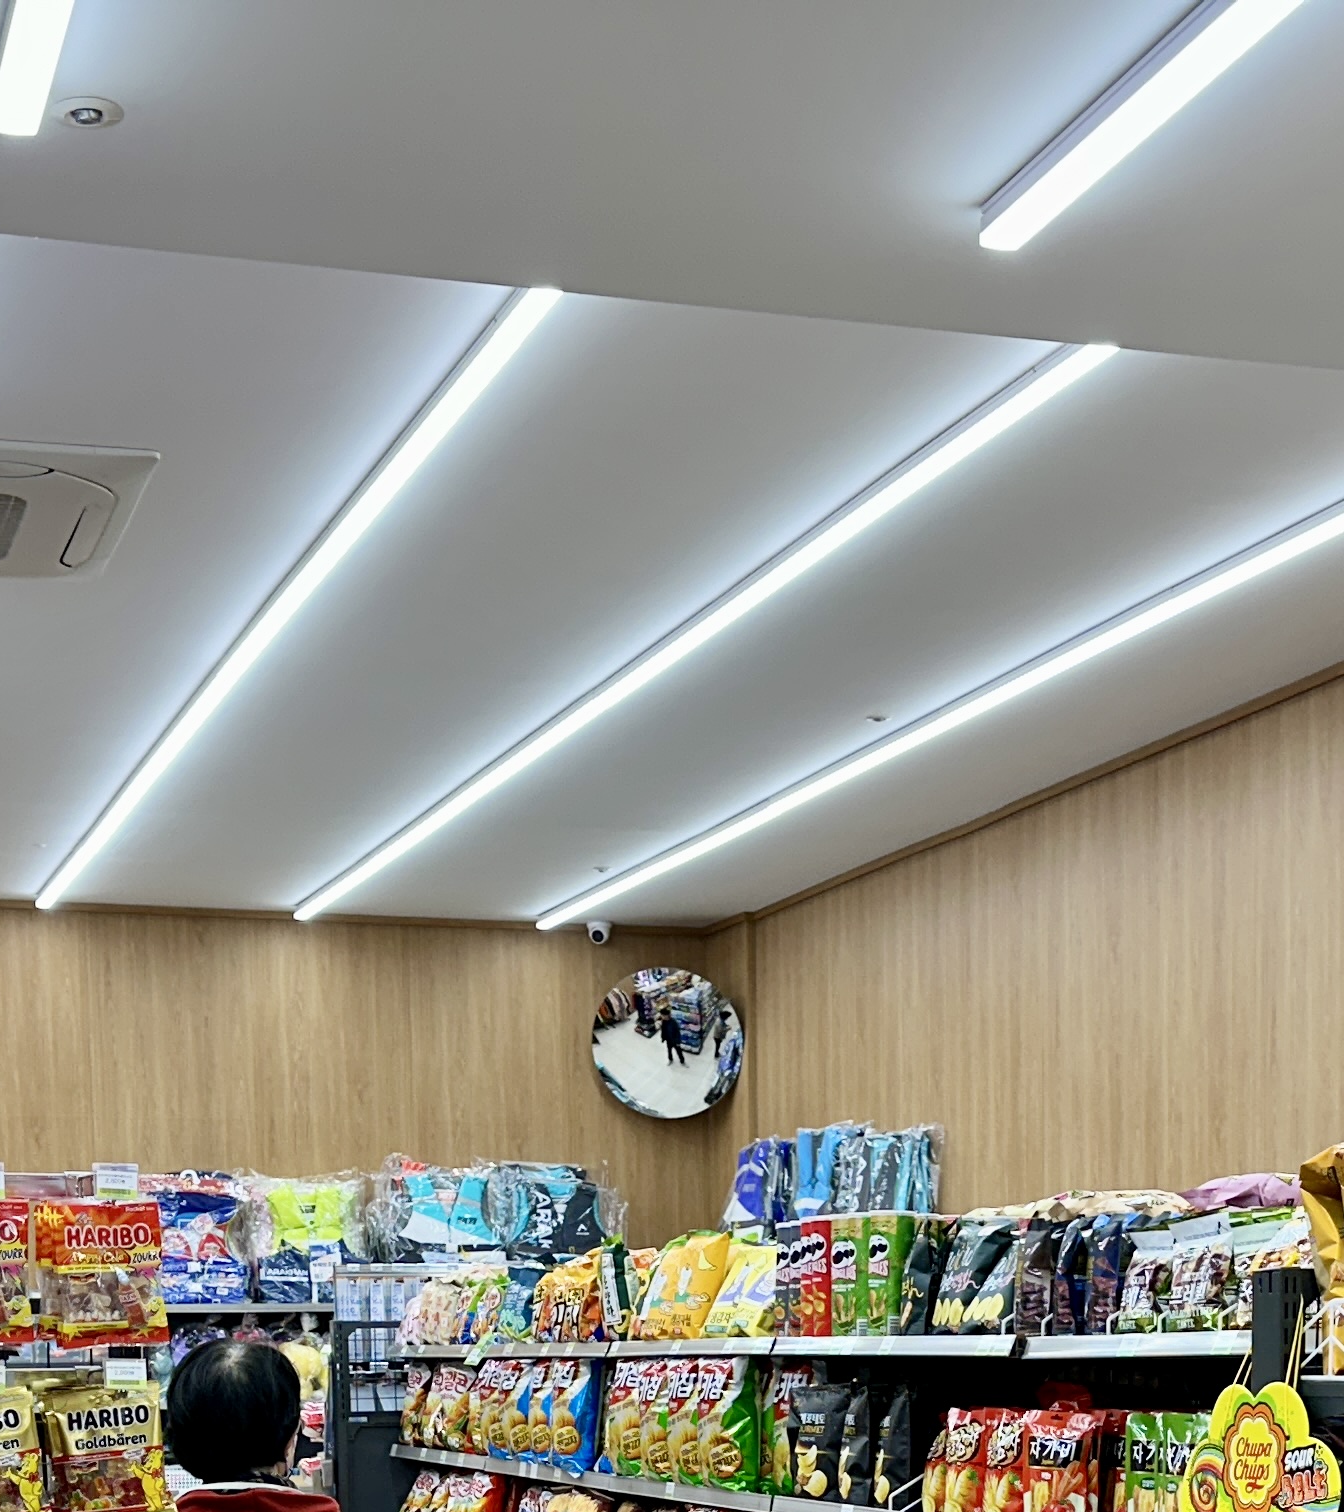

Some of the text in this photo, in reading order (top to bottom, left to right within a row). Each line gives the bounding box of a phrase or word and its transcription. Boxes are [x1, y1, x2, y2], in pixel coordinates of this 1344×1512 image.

[65, 1223, 153, 1248] HARIBO
[68, 1404, 150, 1429] HARIBO
[75, 1432, 147, 1451] Goldbären
[1236, 1437, 1271, 1458] Chupa
[1233, 1457, 1271, 1485] Chups
[1284, 1454, 1315, 1473] SOUR
